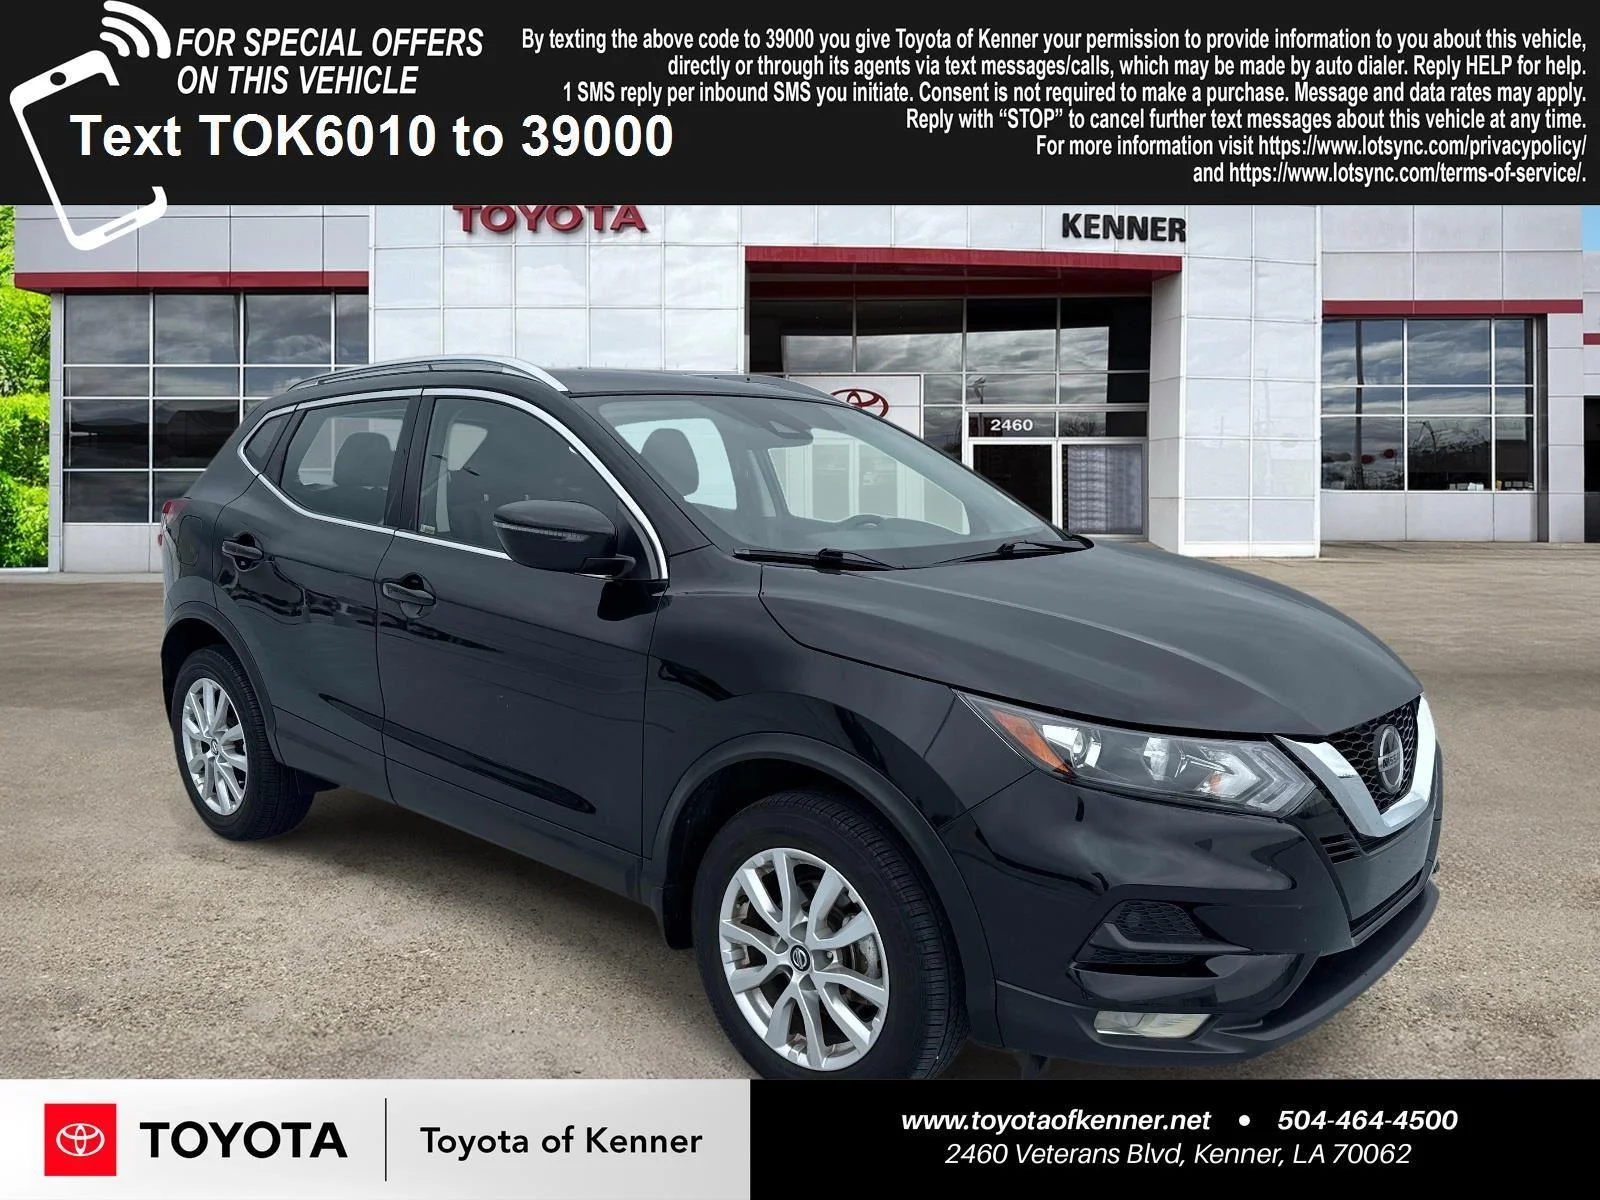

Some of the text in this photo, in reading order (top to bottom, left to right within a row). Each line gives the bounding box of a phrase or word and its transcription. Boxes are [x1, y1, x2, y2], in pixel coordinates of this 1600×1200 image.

[453, 205, 647, 232] TOYOTA
[1062, 213, 1186, 242] KENNER
[991, 418, 1034, 432] 2460
